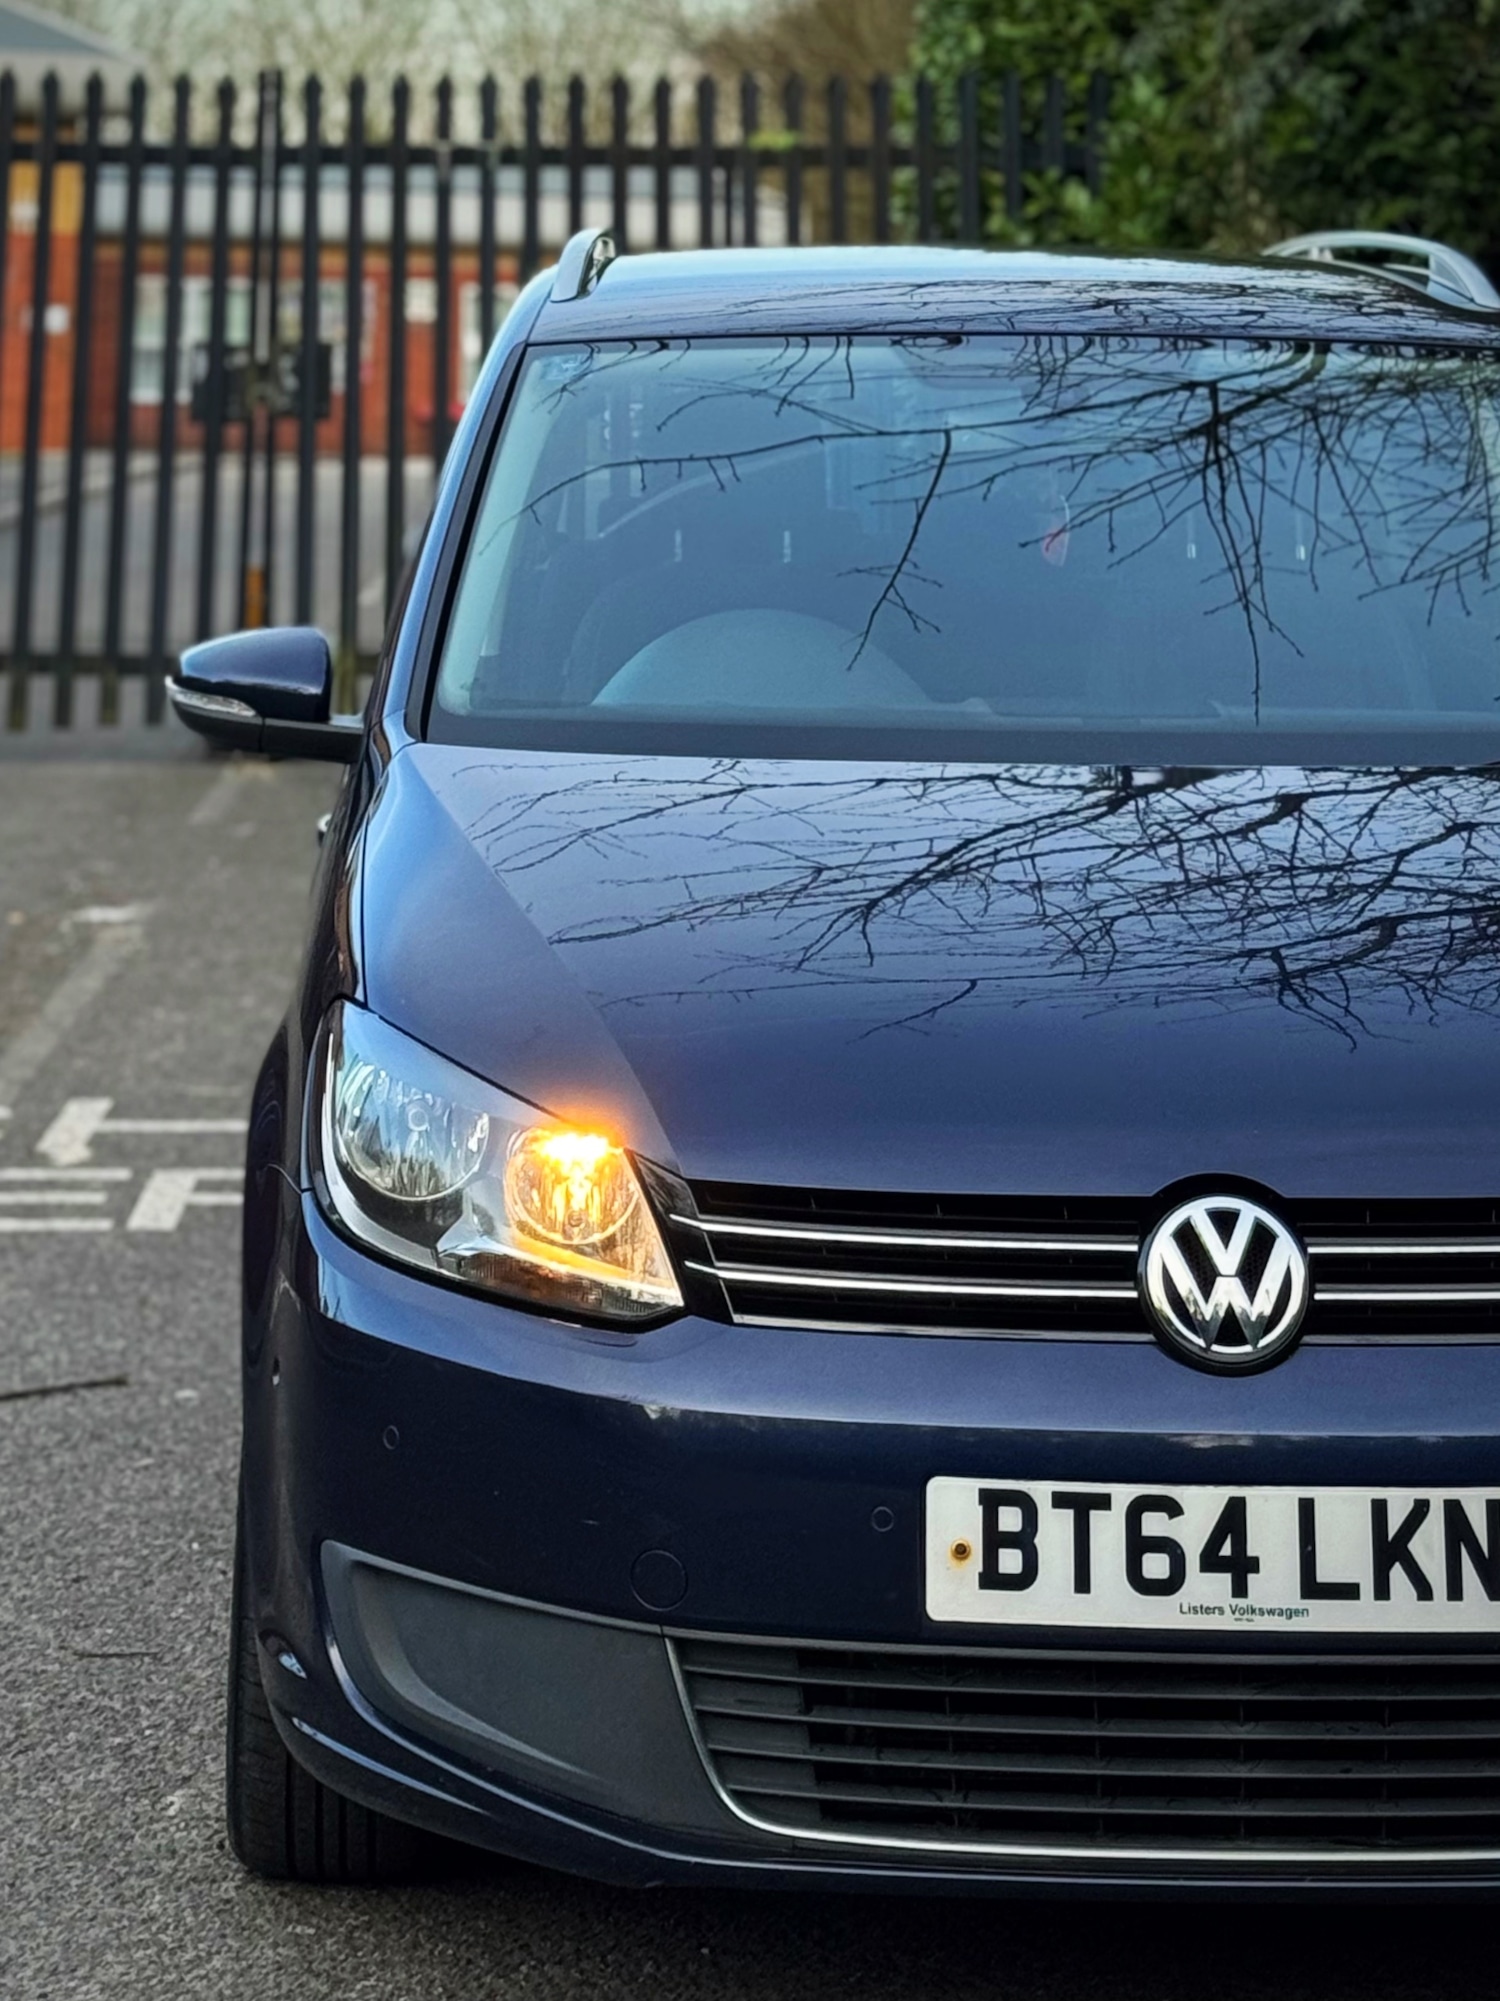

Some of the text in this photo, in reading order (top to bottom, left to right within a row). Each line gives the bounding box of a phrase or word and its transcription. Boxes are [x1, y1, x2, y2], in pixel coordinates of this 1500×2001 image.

[978, 1488, 1500, 1602] BT64 LKN
[1179, 1602, 1309, 1620] Listers Volkswagen
